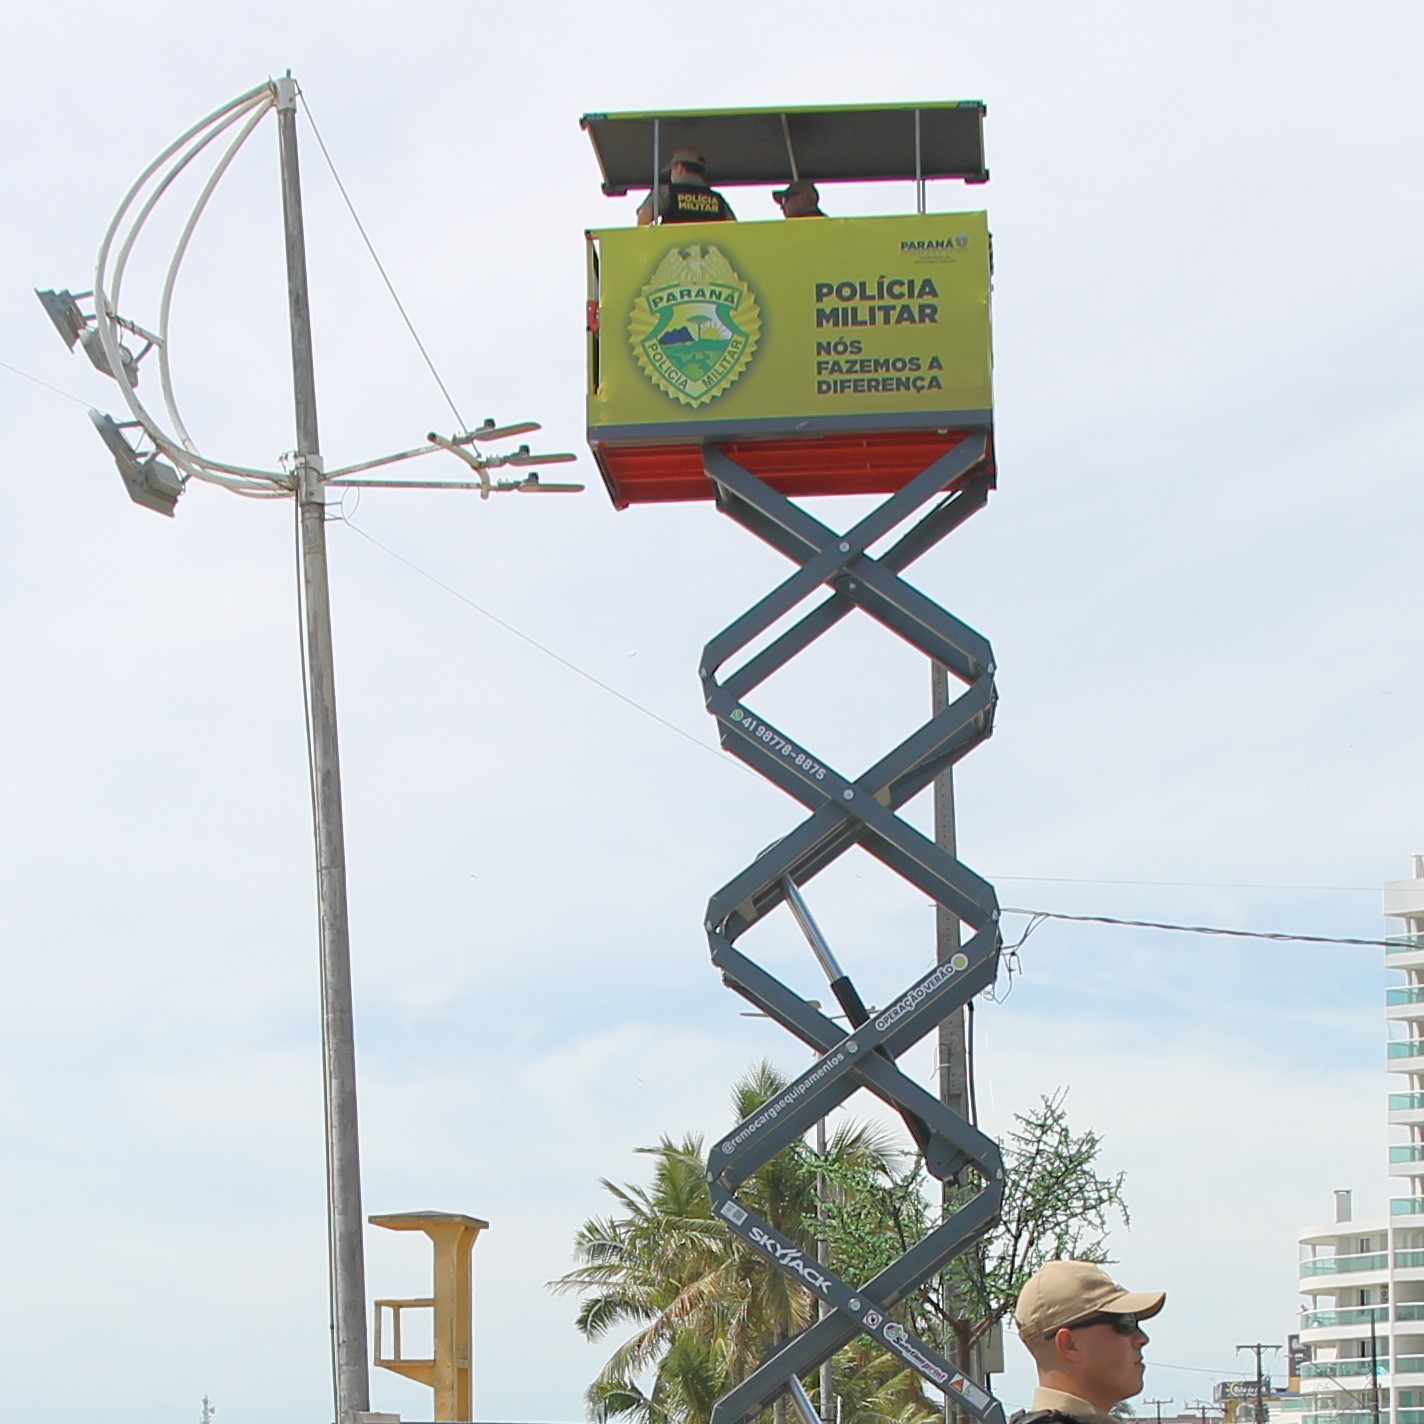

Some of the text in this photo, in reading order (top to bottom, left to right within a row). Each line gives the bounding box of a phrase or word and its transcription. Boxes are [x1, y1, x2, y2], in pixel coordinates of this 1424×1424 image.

[678, 201, 718, 212] MILITAR
[651, 286, 736, 308] PARANÁ
[816, 274, 939, 303] POLÍCIA
[816, 303, 938, 328] MILITAR
[816, 336, 863, 356] NÓS
[701, 339, 743, 389] MILITAR
[816, 355, 944, 376] FAZEMOS A
[817, 375, 943, 395] DIFERENÇA
[742, 717, 757, 731] 41
[876, 964, 955, 1030] OPERAÇÃO VERÃO
[721, 1052, 845, 1155] @remocargaequipamentos
[748, 1226, 832, 1295] SKYJACK
